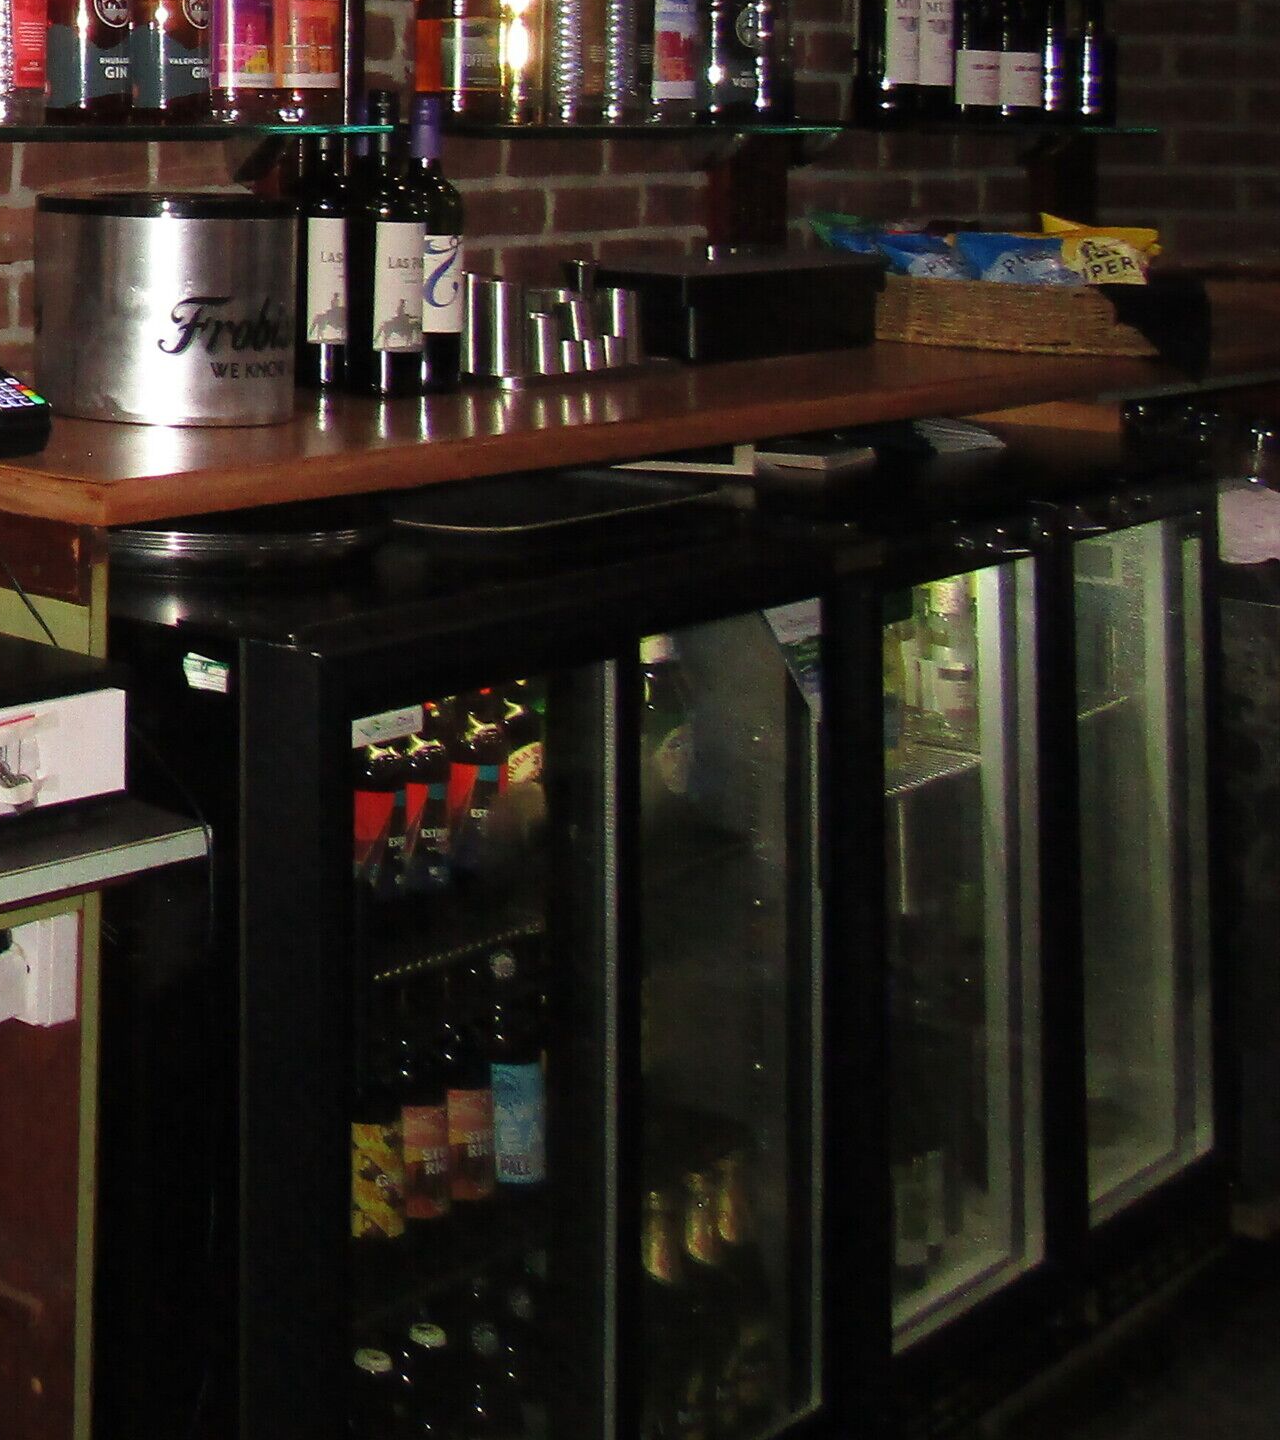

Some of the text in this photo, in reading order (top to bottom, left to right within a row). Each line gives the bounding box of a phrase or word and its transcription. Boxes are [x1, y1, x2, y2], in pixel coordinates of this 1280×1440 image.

[104, 66, 128, 79] GIN
[320, 251, 344, 263] LAS
[210, 362, 241, 379] WE
